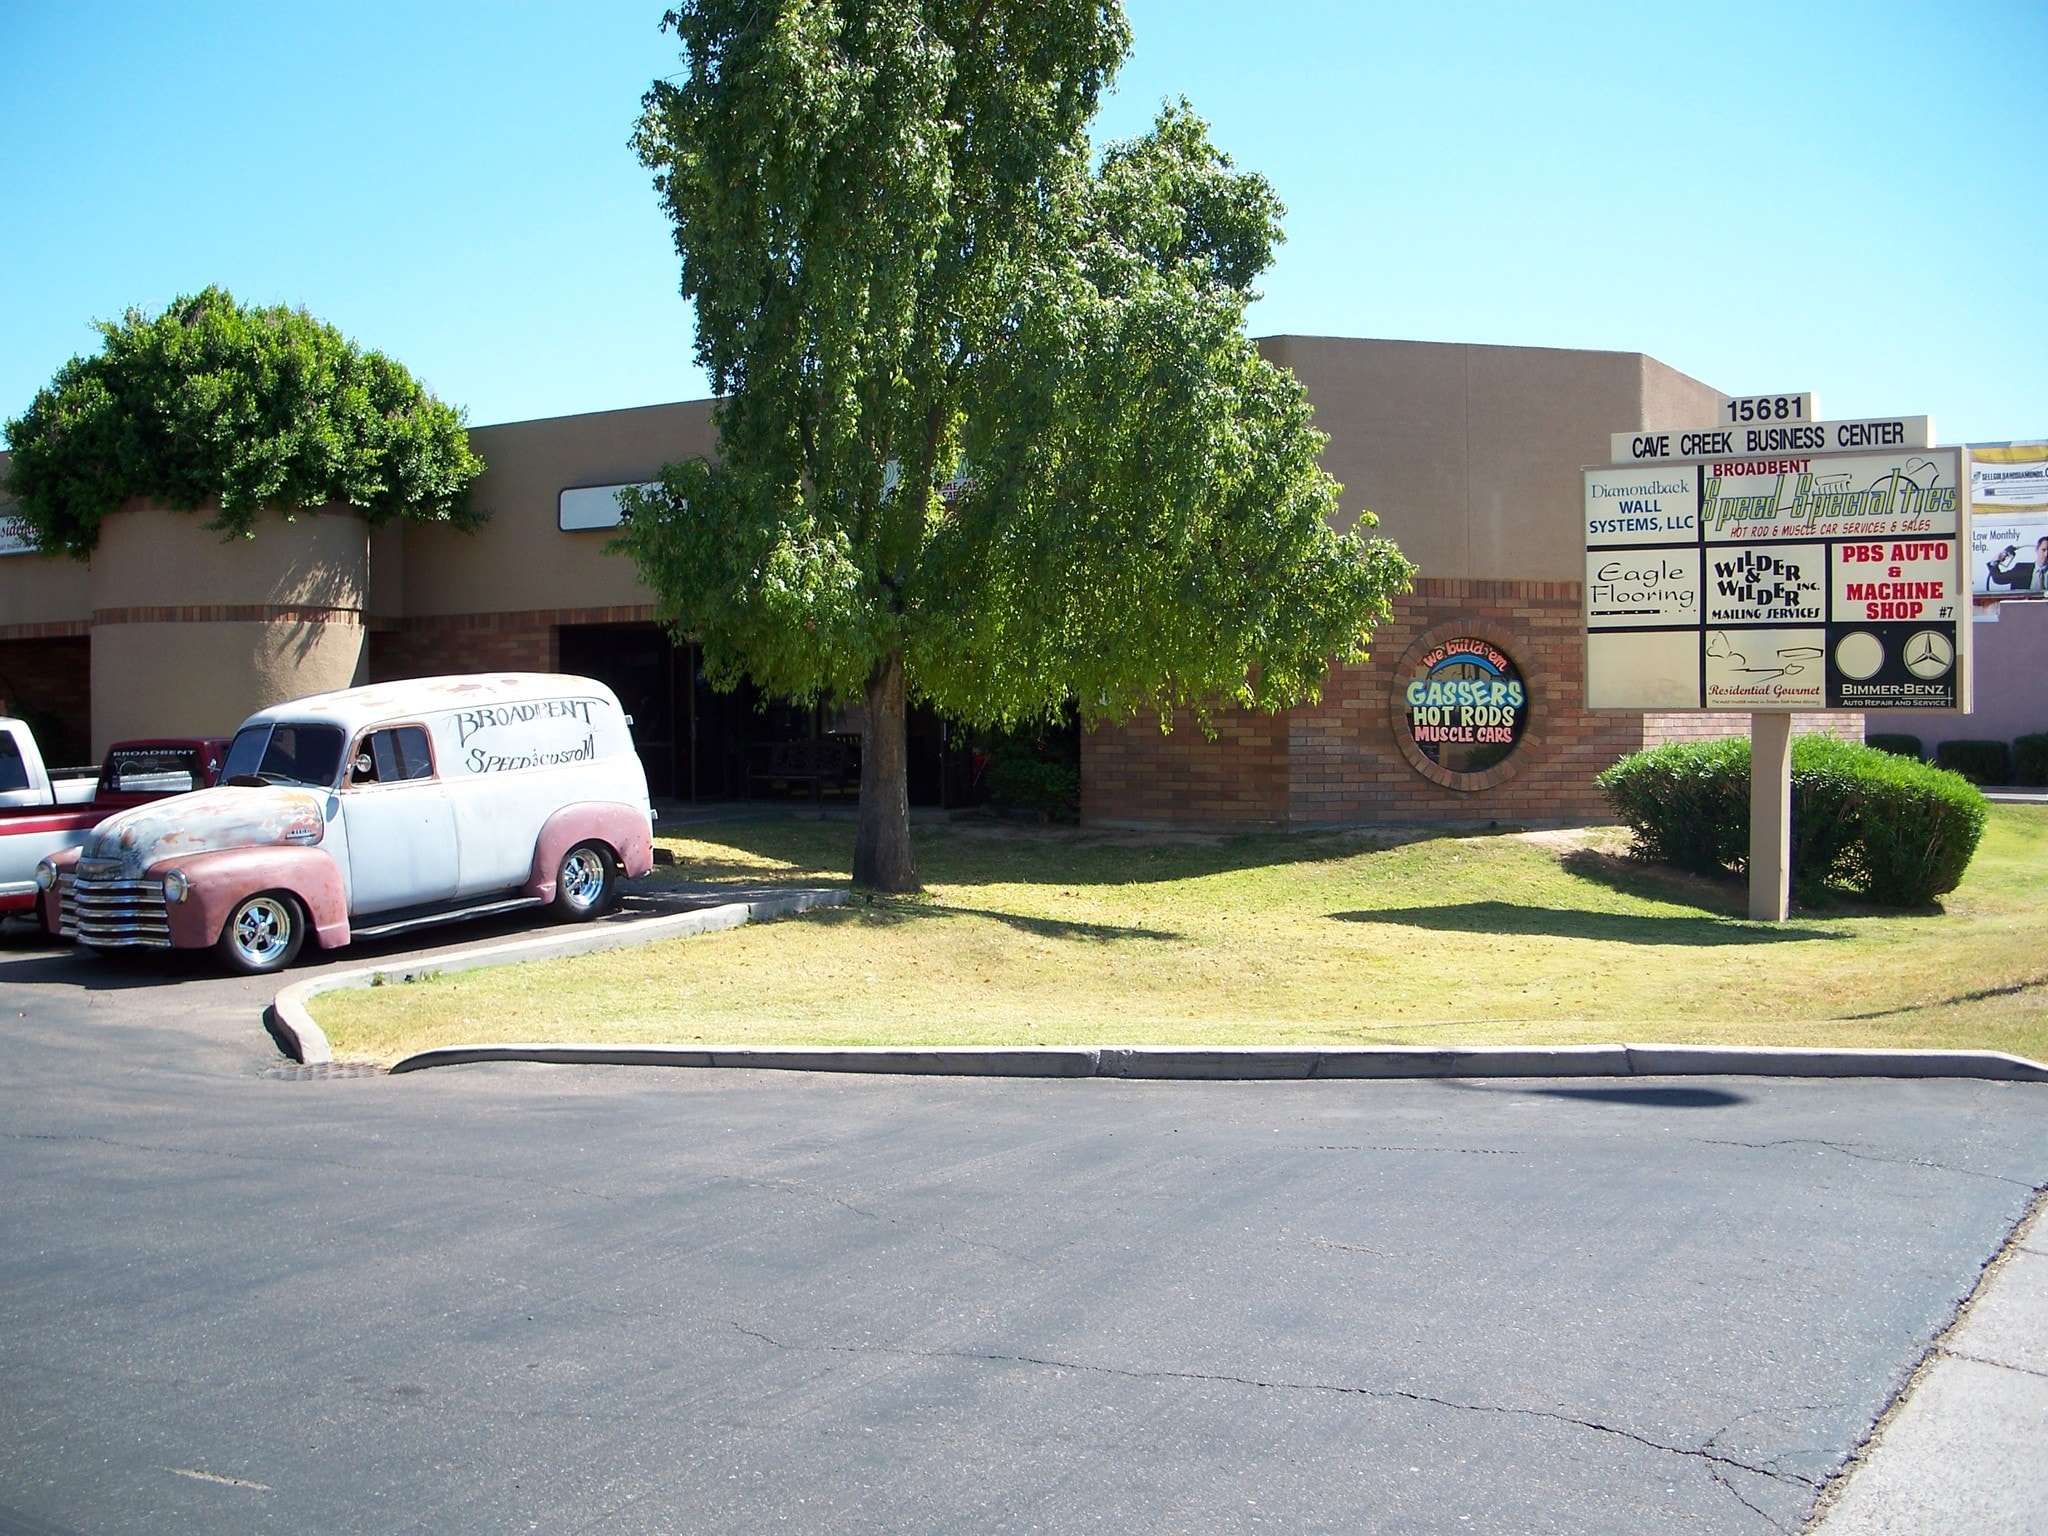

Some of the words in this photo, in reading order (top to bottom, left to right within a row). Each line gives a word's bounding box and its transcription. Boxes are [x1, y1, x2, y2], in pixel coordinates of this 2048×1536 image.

[1727, 397, 1801, 421] 15681
[1632, 436, 1669, 458] CAVE
[1681, 432, 1733, 455] CREEK
[1747, 426, 1824, 451] BUSINESS
[1838, 422, 1904, 447] CENTER
[1713, 459, 1810, 477] BROADBENT
[1591, 479, 1689, 498] Diamondback
[1619, 499, 1662, 514] WALL
[1700, 474, 1785, 532] Speed
[1791, 468, 1956, 529] Specialties
[1589, 517, 1663, 533] SYSTEMS,
[1667, 515, 1694, 529] LLC
[1730, 527, 1747, 538] HOT
[1751, 526, 1769, 537] ROD
[1772, 525, 1778, 537] &
[1782, 524, 1817, 536] MUSCLE
[1821, 523, 1837, 535] CAR
[1842, 521, 1886, 534] SERVICES
[1890, 521, 1897, 532] &
[1901, 519, 1931, 532] SALES
[1972, 530, 1988, 540] Low
[1990, 528, 2020, 541] Monthly
[1842, 544, 1884, 563] PBS
[1891, 542, 1948, 561] AUTO
[1597, 560, 1685, 588] Eagle
[1714, 551, 1801, 581] WILDER
[1745, 567, 1761, 583] &
[1888, 566, 1902, 577] &
[1590, 583, 1694, 608] Flooring
[1717, 580, 1800, 606] WILDER
[1796, 582, 1820, 591] INC.
[1846, 582, 1944, 600] MACHINE
[1712, 608, 1761, 619] MAILING
[1766, 607, 1820, 618] SERVICES
[1866, 602, 1923, 619] SHOP
[1939, 606, 1954, 618] #7
[1423, 649, 1443, 667] we
[1446, 638, 1485, 655] build
[1406, 680, 1524, 708] GASSERS
[1708, 684, 1770, 695] Residential
[1773, 684, 1820, 698] Gourmet
[1842, 683, 1944, 695] BIMMER-BENZ
[1413, 706, 1454, 726] HOT
[1461, 706, 1515, 727] RODS
[1414, 726, 1474, 742] MUSCLE
[1477, 727, 1512, 743] CARS
[113, 749, 196, 757] BROADBENT
